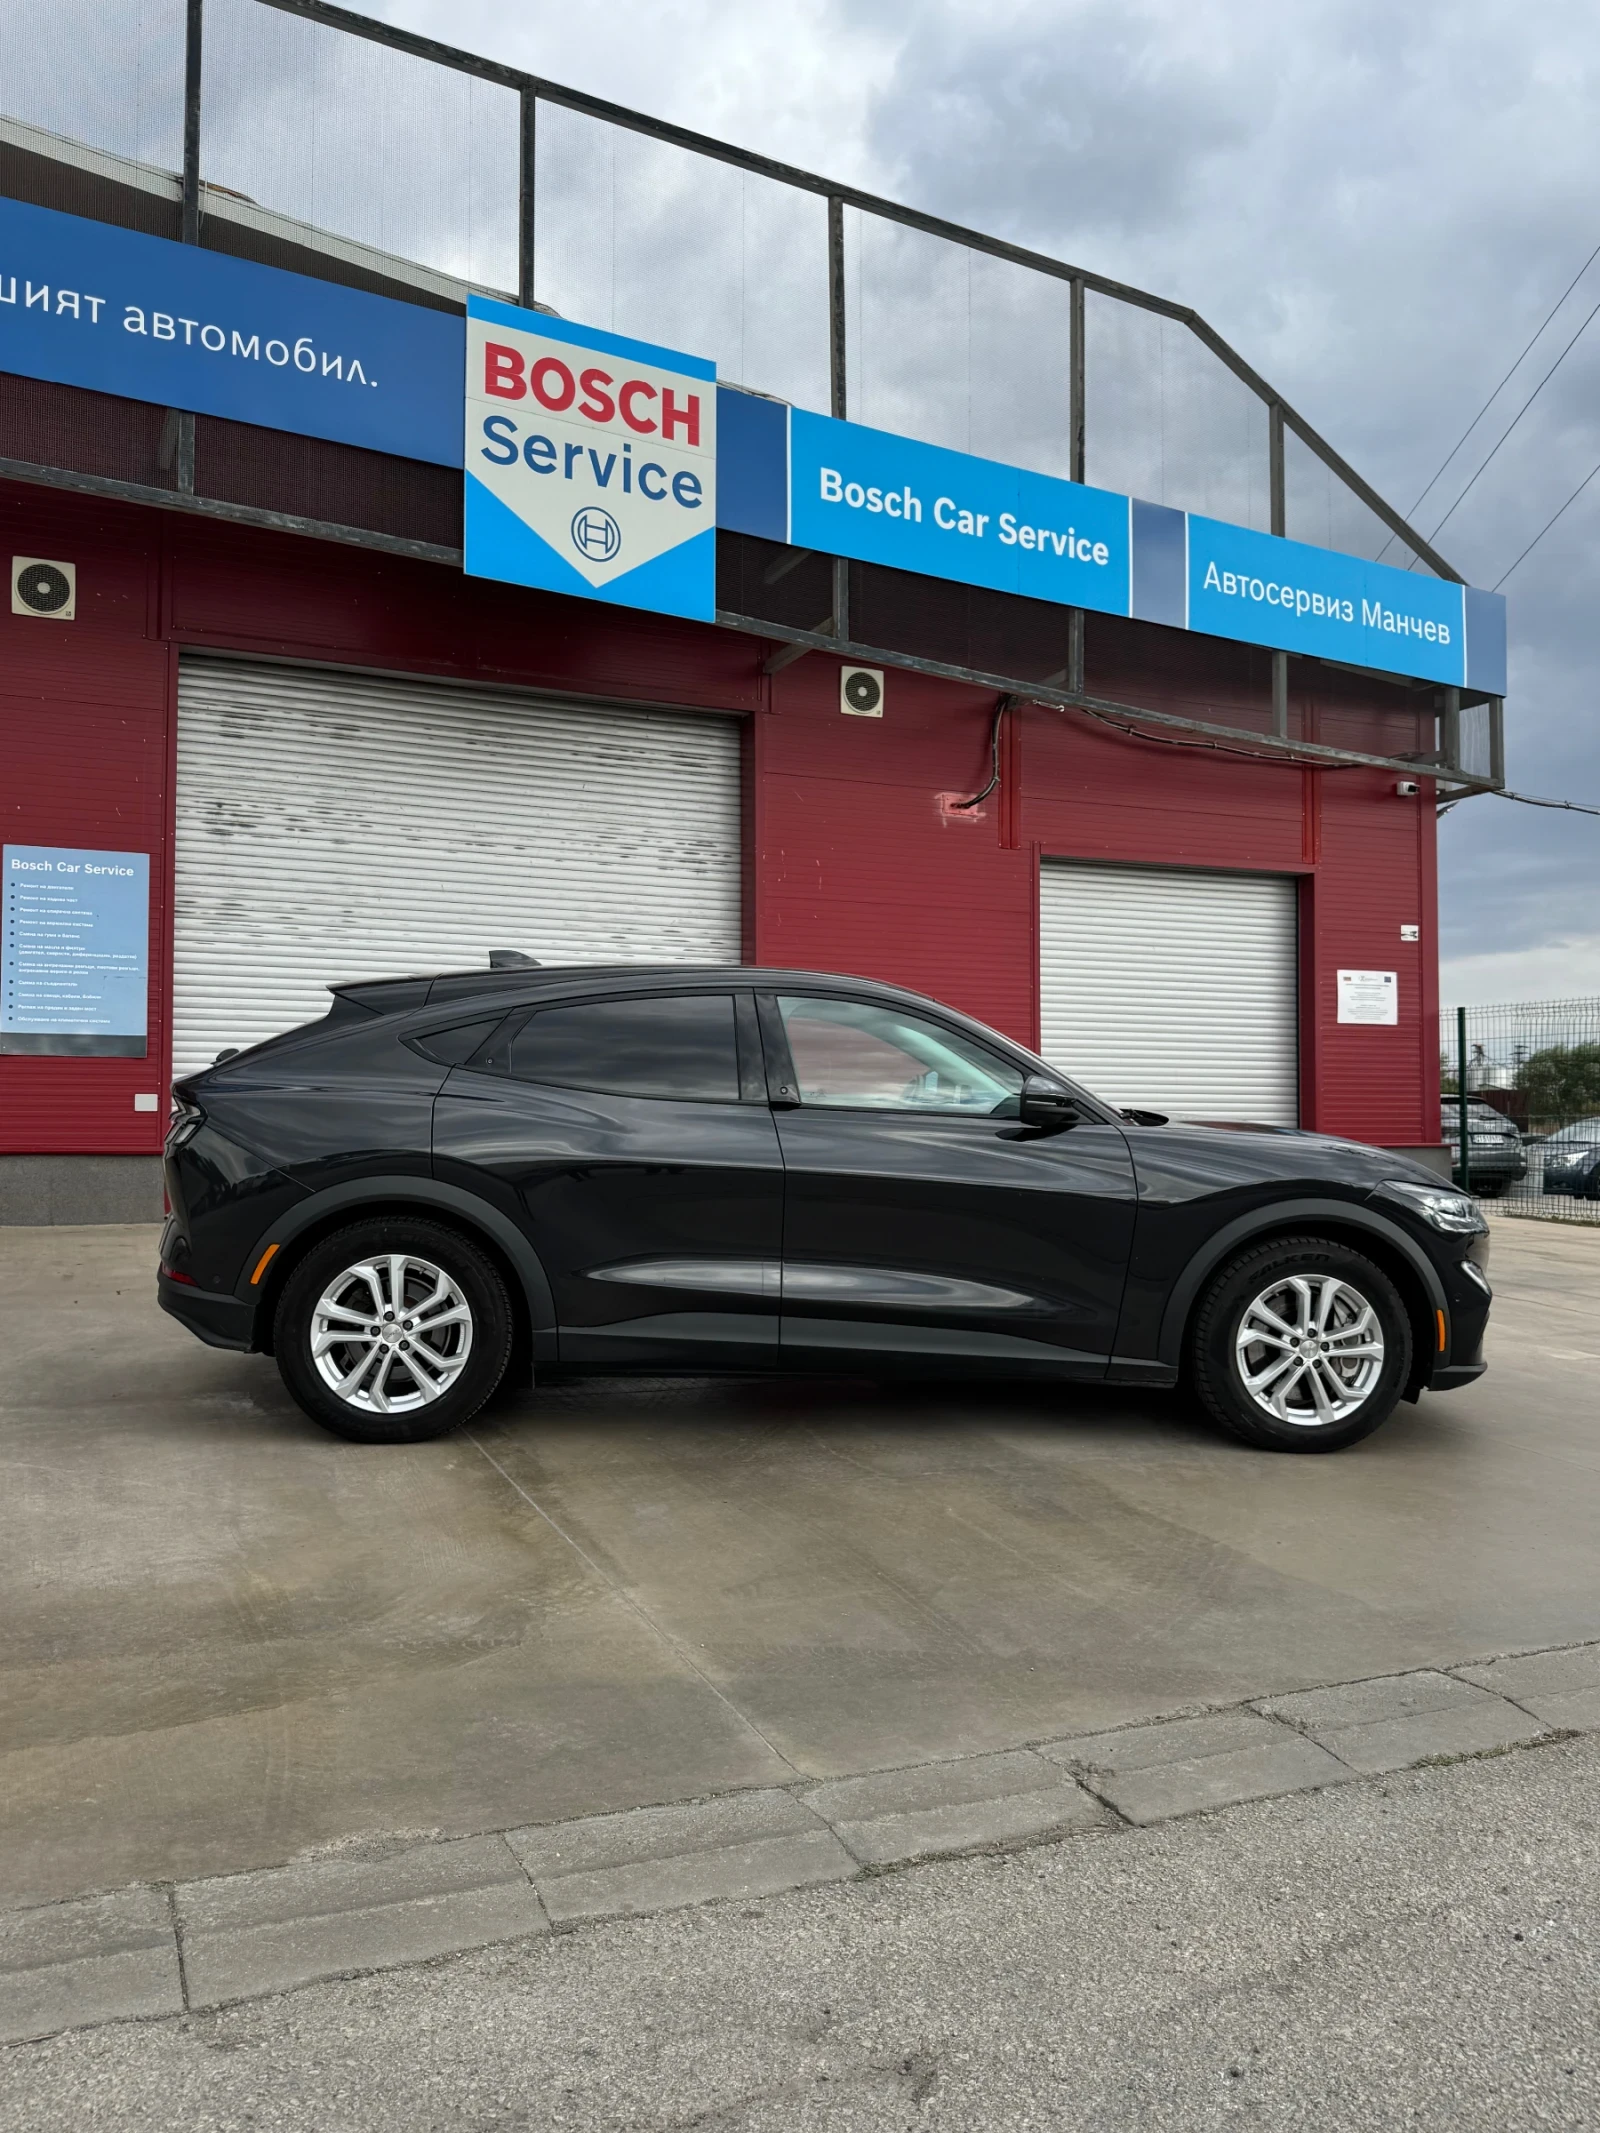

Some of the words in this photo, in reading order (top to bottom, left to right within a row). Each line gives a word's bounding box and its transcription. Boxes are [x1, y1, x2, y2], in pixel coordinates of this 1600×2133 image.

[123, 305, 378, 388] автомобил.
[485, 341, 700, 447] BOSCH
[481, 415, 703, 509] Service
[819, 466, 923, 523] Bosch
[933, 495, 989, 539] Car
[998, 513, 1110, 567] Service
[1203, 561, 1354, 623] Автосервиз
[1361, 598, 1451, 645] Манчев
[11, 858, 52, 871] Bosch
[57, 861, 81, 873] Car
[84, 863, 134, 877] Service
